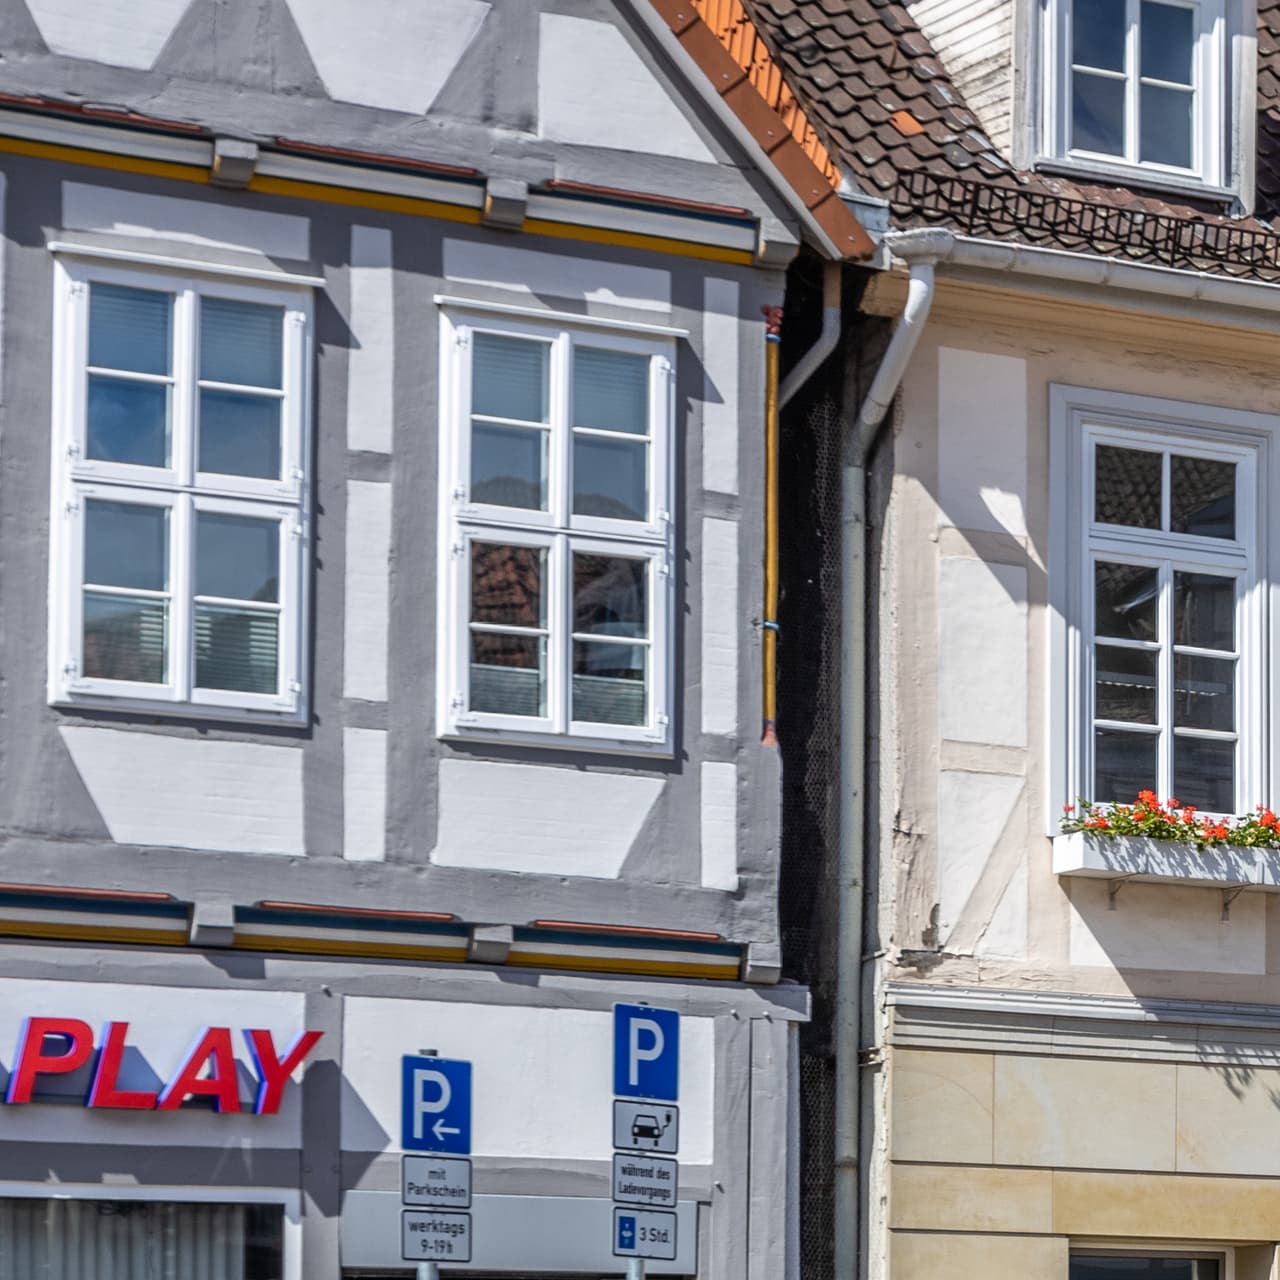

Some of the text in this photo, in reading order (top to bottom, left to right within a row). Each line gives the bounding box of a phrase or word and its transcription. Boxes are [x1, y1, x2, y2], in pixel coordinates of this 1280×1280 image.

[628, 1017, 665, 1086] P
[7, 1016, 325, 1114] PLAY
[412, 1068, 451, 1139] P
[428, 1167, 447, 1180] mit
[620, 1163, 671, 1180] während des
[407, 1182, 467, 1199] Parkschein
[618, 1180, 672, 1201] Ladevorgangs
[408, 1220, 466, 1238] werktags
[639, 1227, 671, 1243] 3 Std.
